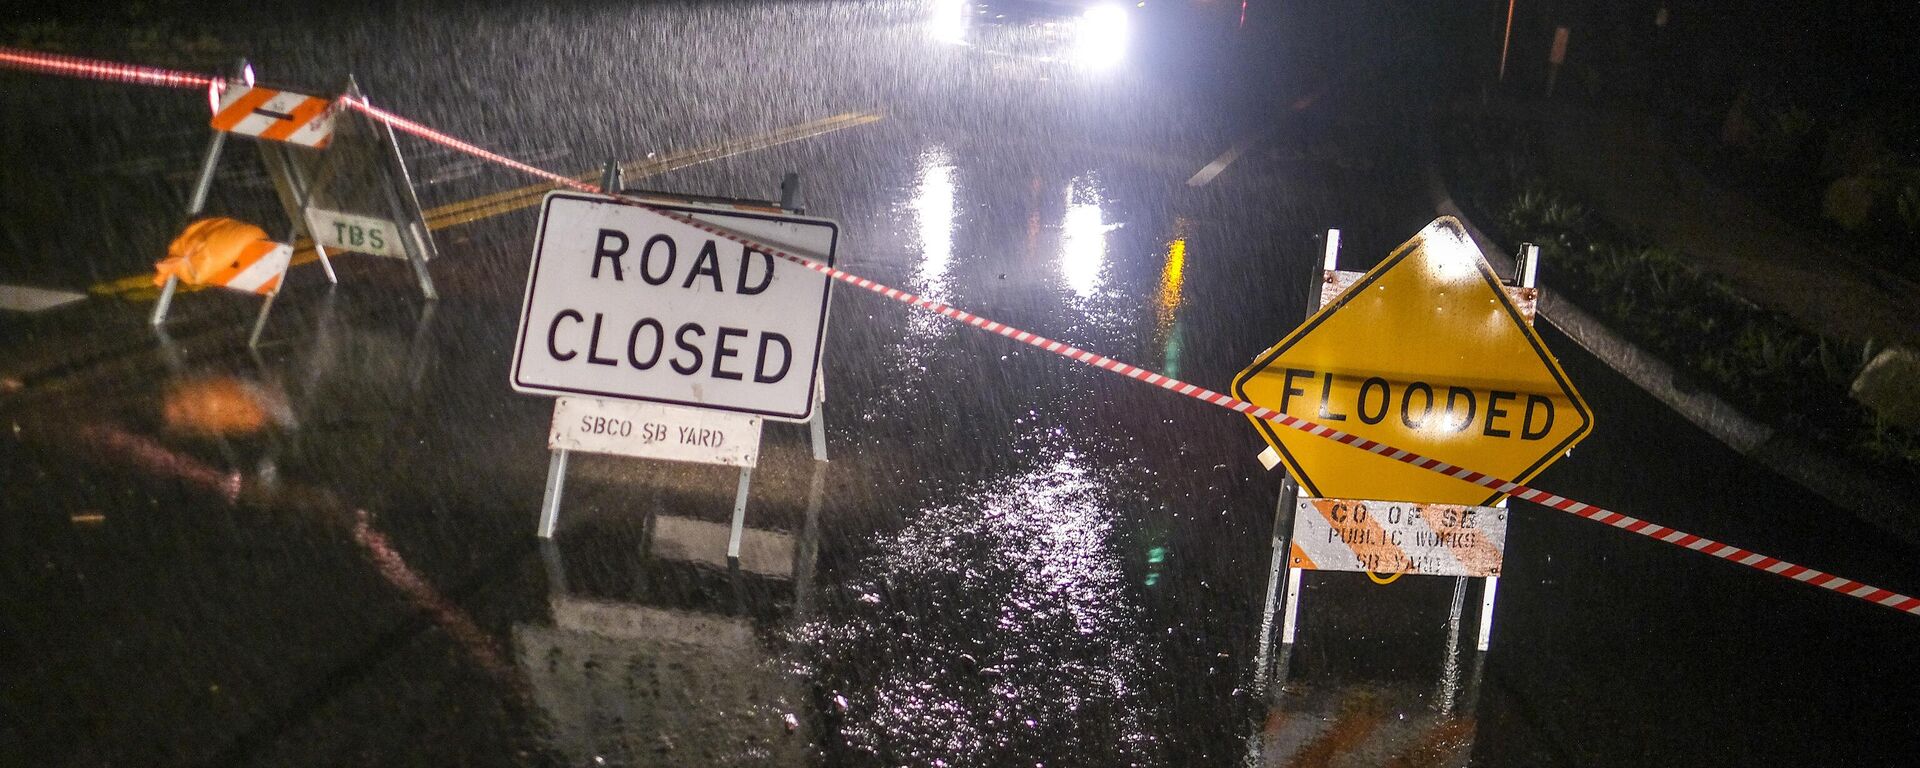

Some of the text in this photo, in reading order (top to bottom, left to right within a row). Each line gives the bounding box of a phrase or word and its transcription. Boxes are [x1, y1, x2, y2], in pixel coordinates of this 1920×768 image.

[332, 220, 385, 250] TBS
[590, 228, 775, 296] ROAD
[546, 308, 793, 385] CLOSED
[1279, 368, 1556, 441] FLOODED
[580, 415, 725, 449] SBCO SB YARD
[1331, 504, 1367, 524] CO
[1327, 527, 1403, 547] PUBLIC
